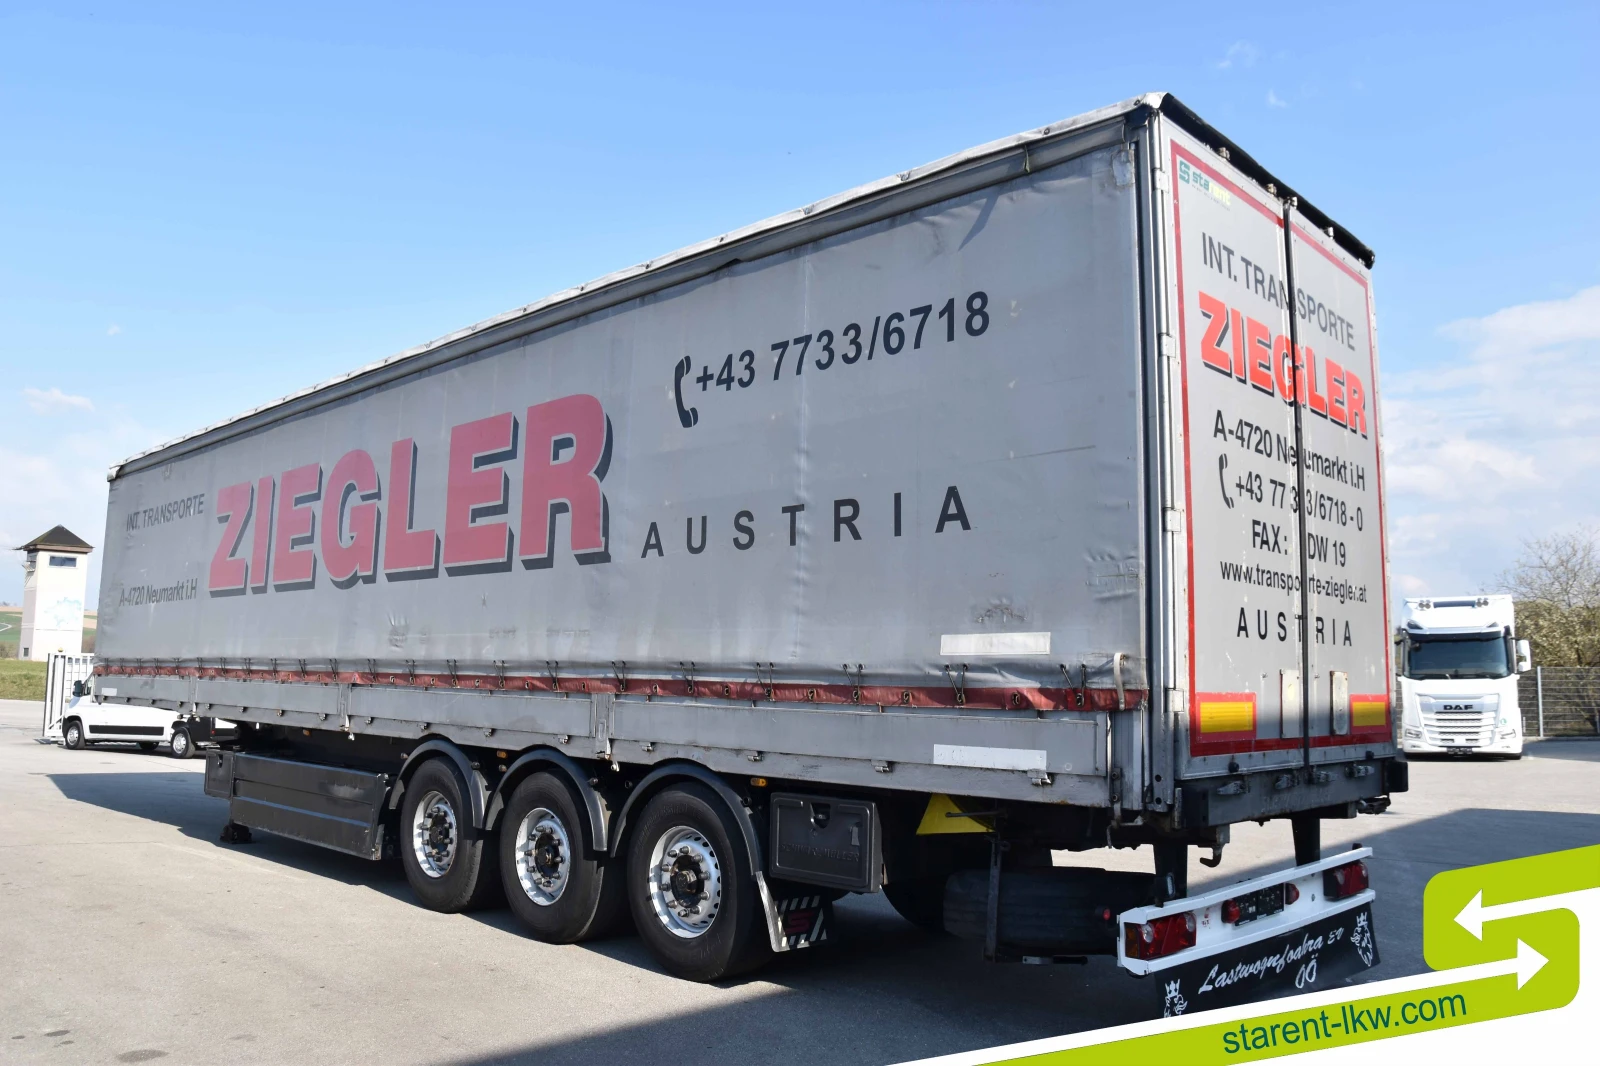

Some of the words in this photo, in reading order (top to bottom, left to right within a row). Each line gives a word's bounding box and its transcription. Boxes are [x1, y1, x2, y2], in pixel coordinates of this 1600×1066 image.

[1202, 232, 1238, 282] INT.
[1240, 257, 1356, 351] TRANSPORTE
[695, 349, 756, 392] +43
[770, 291, 990, 381] 7733/6718
[1199, 290, 1368, 440] ZIEGLER
[1213, 409, 1273, 459] A-4720
[1276, 434, 1348, 485] Neumarkt
[1350, 462, 1365, 491] i.H
[143, 493, 205, 529] TRANSPORTE
[208, 393, 613, 598] ZIEGLER
[1235, 471, 1263, 503] +43
[640, 485, 972, 559] AUSTRIA
[1307, 532, 1329, 563] DW
[1332, 540, 1346, 567] 19
[119, 585, 145, 607] A-4720
[145, 581, 184, 604] Neumarkt
[1220, 560, 1368, 605] www.transporte-ziegler.at
[1237, 607, 1352, 647] AUSTRIA
